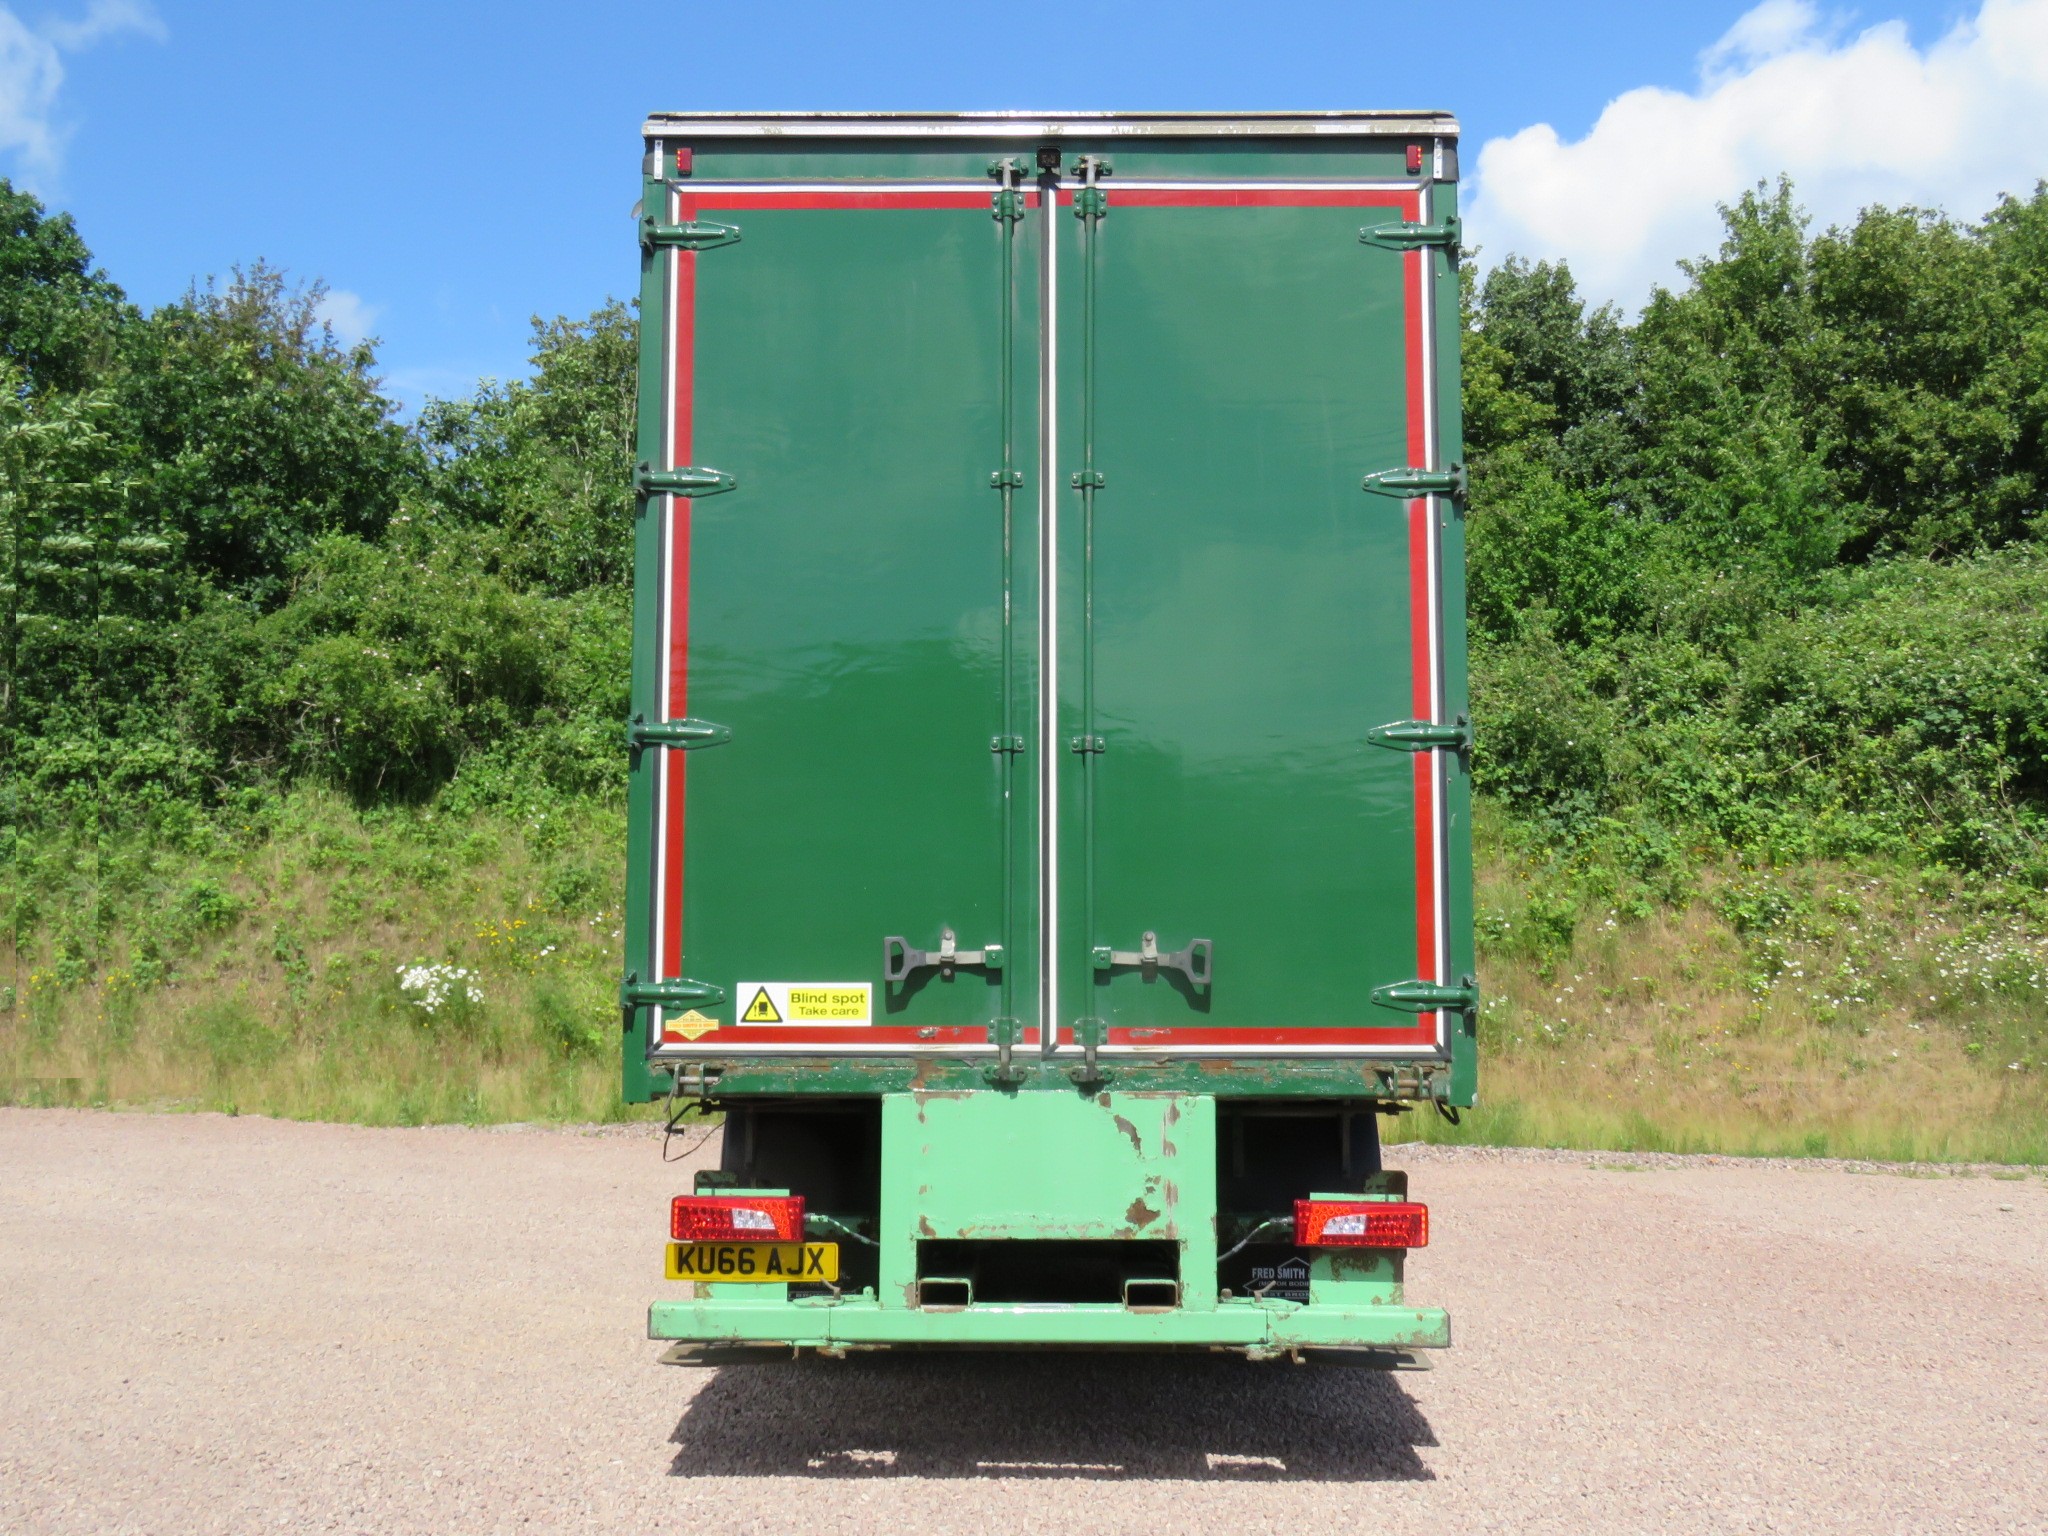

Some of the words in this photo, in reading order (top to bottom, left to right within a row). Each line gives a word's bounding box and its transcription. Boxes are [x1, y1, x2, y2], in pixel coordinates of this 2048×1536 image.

[791, 993, 827, 1003] Blind
[832, 993, 865, 1006] spot
[799, 1006, 827, 1016] Take
[831, 1008, 859, 1016] care
[677, 1246, 755, 1276] KU66
[766, 1247, 824, 1276] AJX
[1252, 1267, 1275, 1279] FRED
[1277, 1267, 1305, 1279] SMITH
